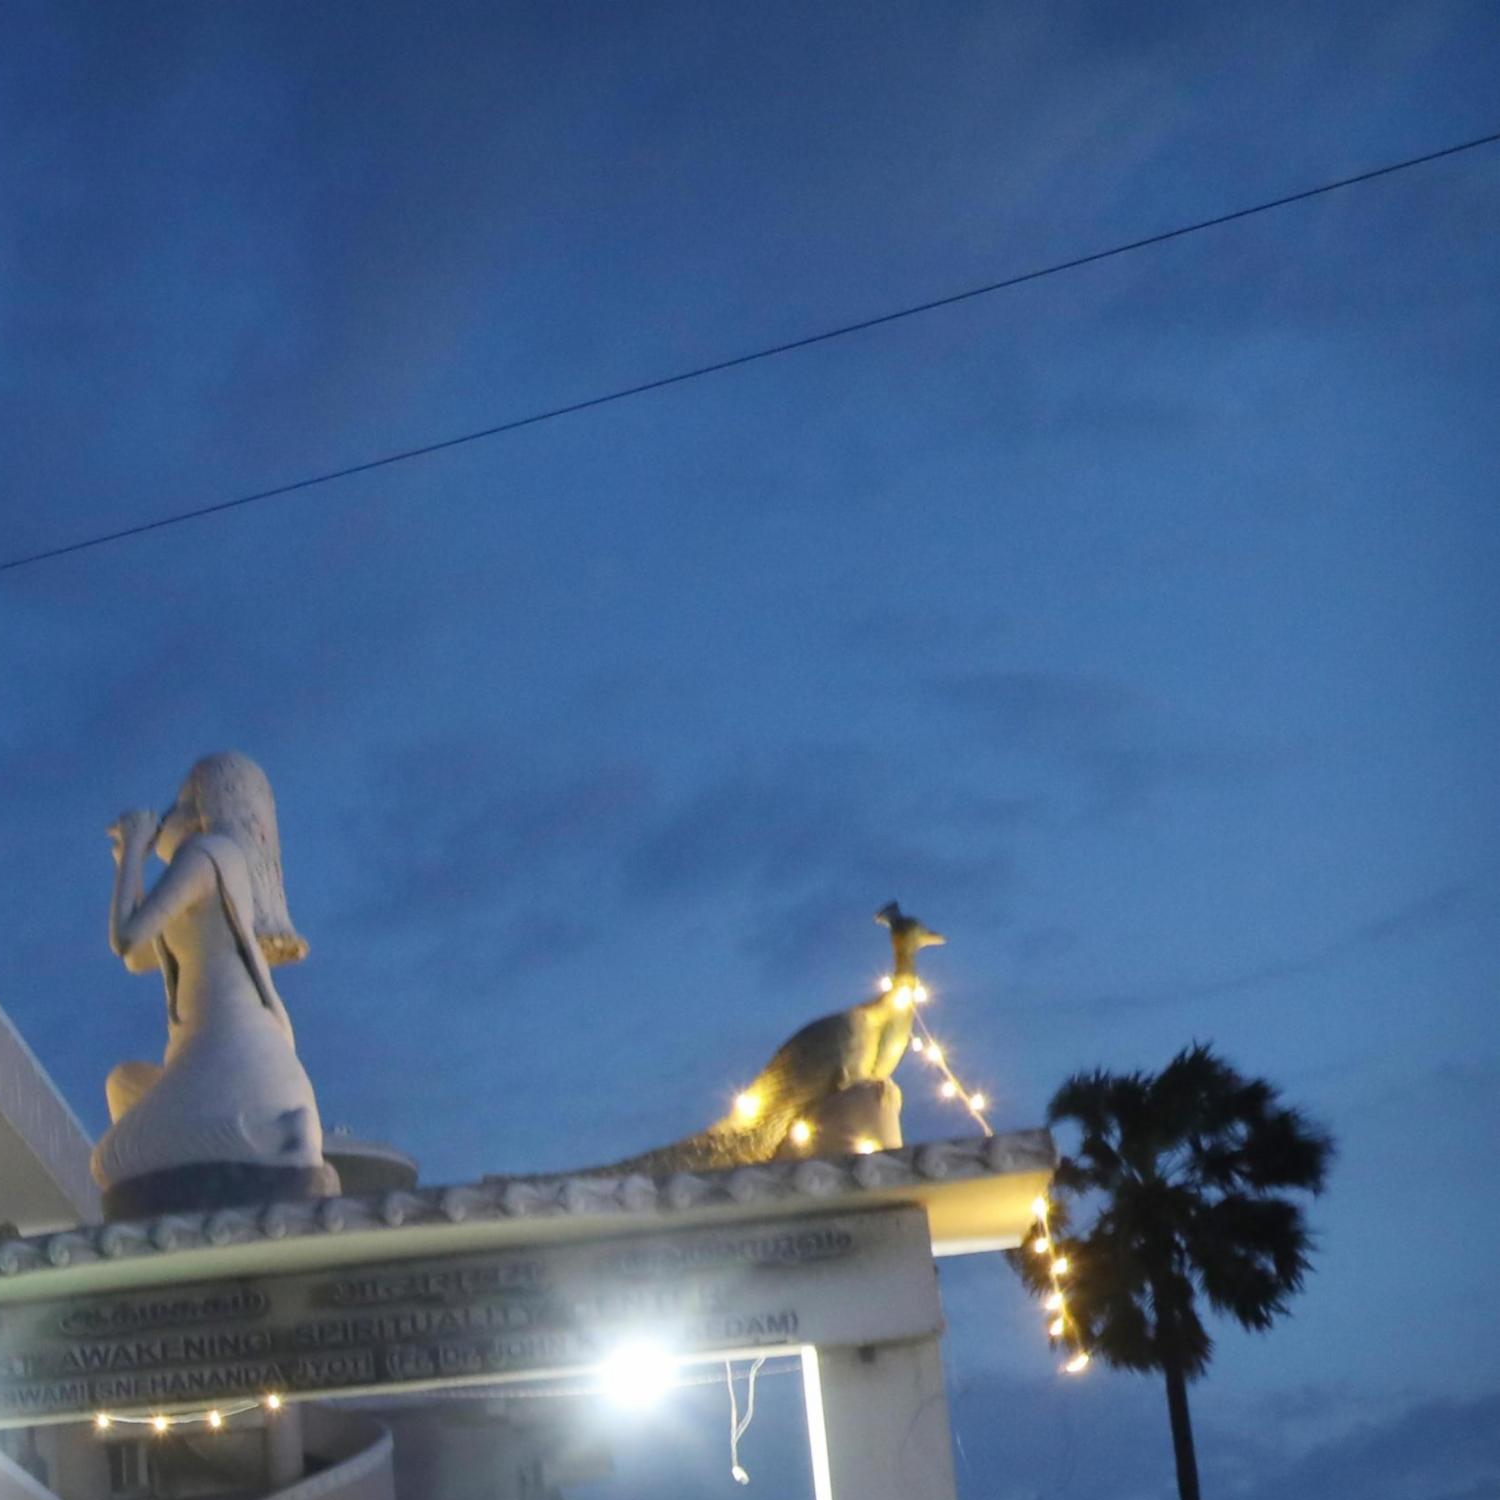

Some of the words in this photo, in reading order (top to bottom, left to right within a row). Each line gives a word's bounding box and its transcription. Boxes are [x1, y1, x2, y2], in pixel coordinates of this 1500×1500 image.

[61, 1330, 272, 1371] AWAKENING
[295, 1300, 539, 1346] SPIRITUALITY
[1, 1381, 88, 1411] SWAMI
[95, 1362, 285, 1402] SNEHANANDA
